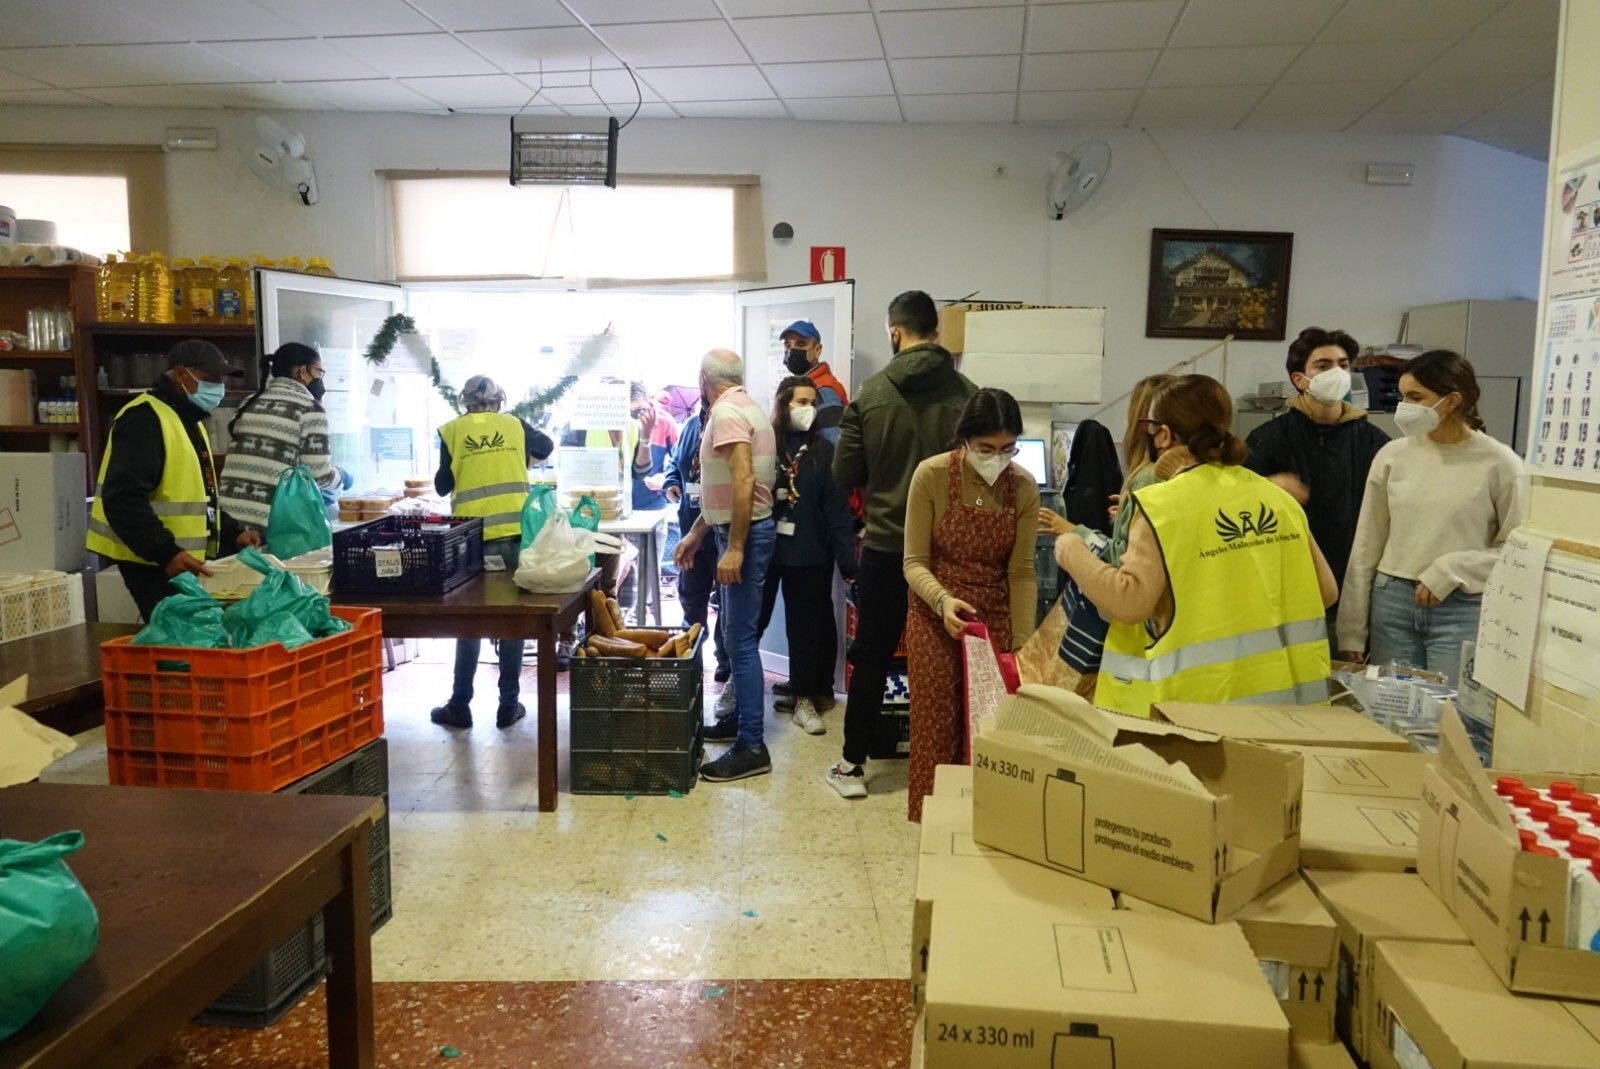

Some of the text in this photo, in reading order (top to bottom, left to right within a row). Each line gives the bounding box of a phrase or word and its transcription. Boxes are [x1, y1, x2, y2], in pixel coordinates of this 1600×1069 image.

[1542, 421, 1551, 439] 17
[1560, 422, 1569, 441] 18
[1579, 422, 1588, 442] 19
[1554, 446, 1565, 465] 25
[1573, 448, 1586, 468] 26
[976, 754, 1035, 783] 24 x 330 ml
[1094, 818, 1172, 848] protegemos tu producto
[1094, 834, 1194, 872] protegemos el medio ambiente
[938, 1023, 1034, 1048] 24 x 330 ml
